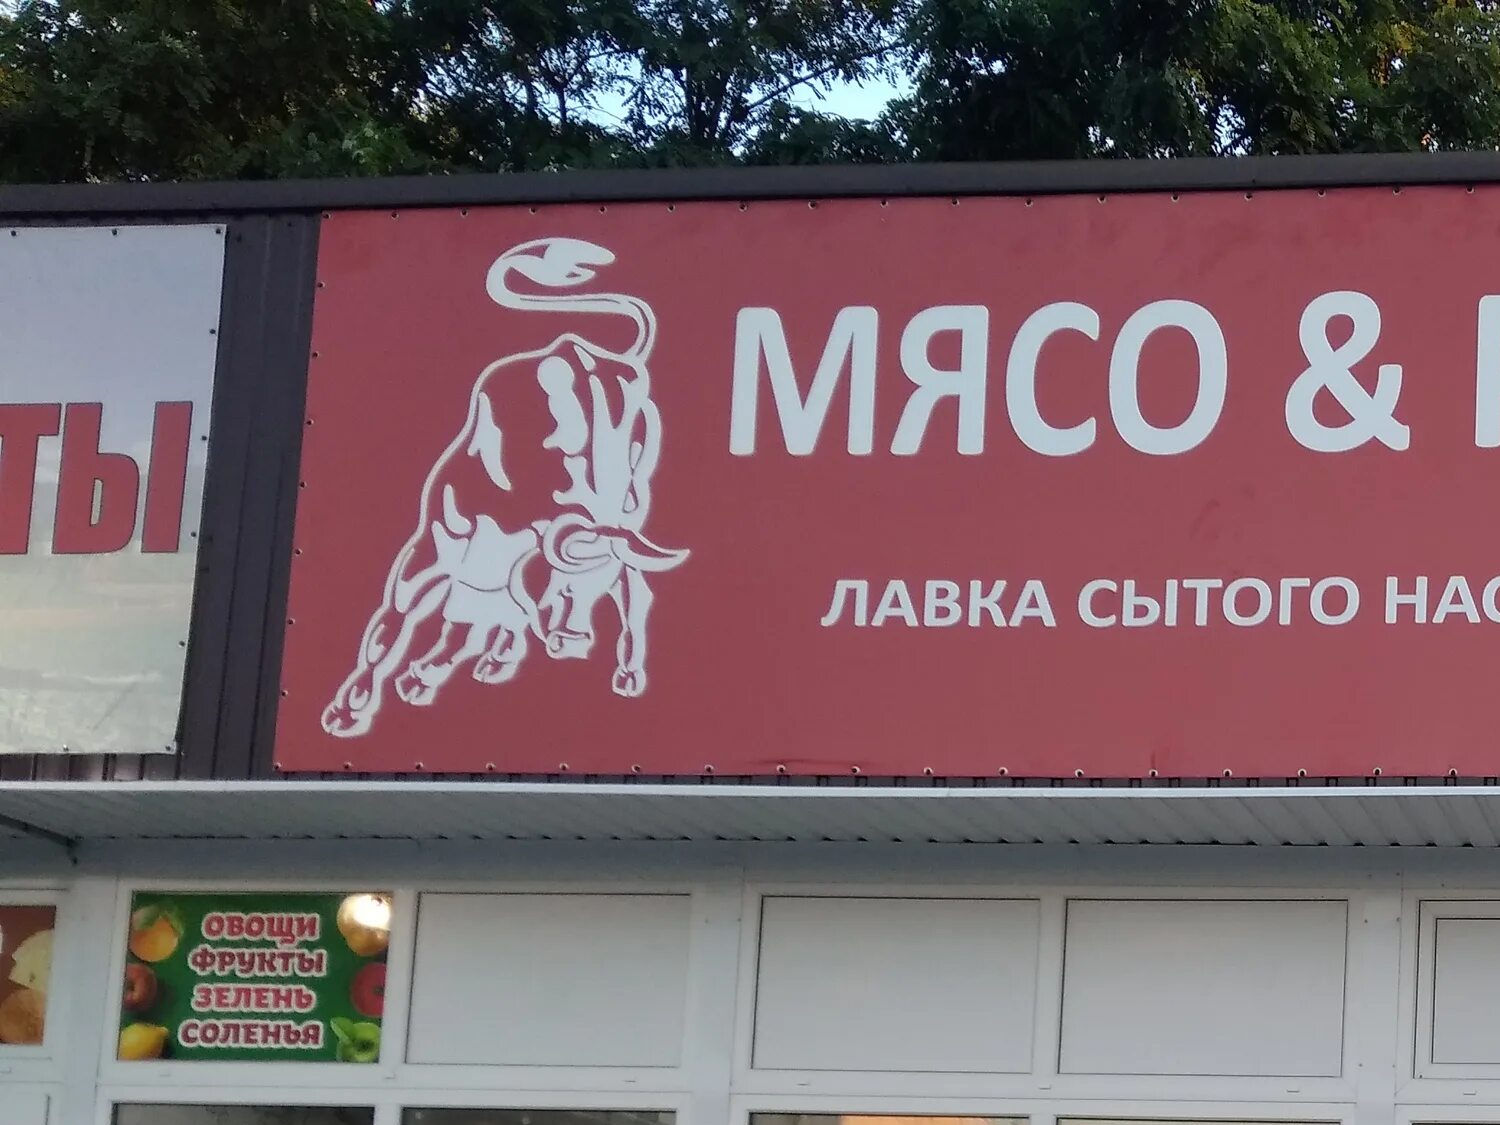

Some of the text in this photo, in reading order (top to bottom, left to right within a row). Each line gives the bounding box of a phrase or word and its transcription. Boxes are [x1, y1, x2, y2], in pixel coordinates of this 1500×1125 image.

[730, 300, 1227, 456] МЯСО
[1285, 291, 1410, 453] &
[819, 579, 1057, 629] ЛАВКА
[1077, 577, 1360, 628] СЫТОГО
[203, 914, 319, 946] ОВОЩИ
[190, 947, 326, 975] ФРУКТЫ
[194, 985, 315, 1010] ЗЕЛЕНЬ
[180, 1021, 322, 1046] СОЛЕНЬЯ
